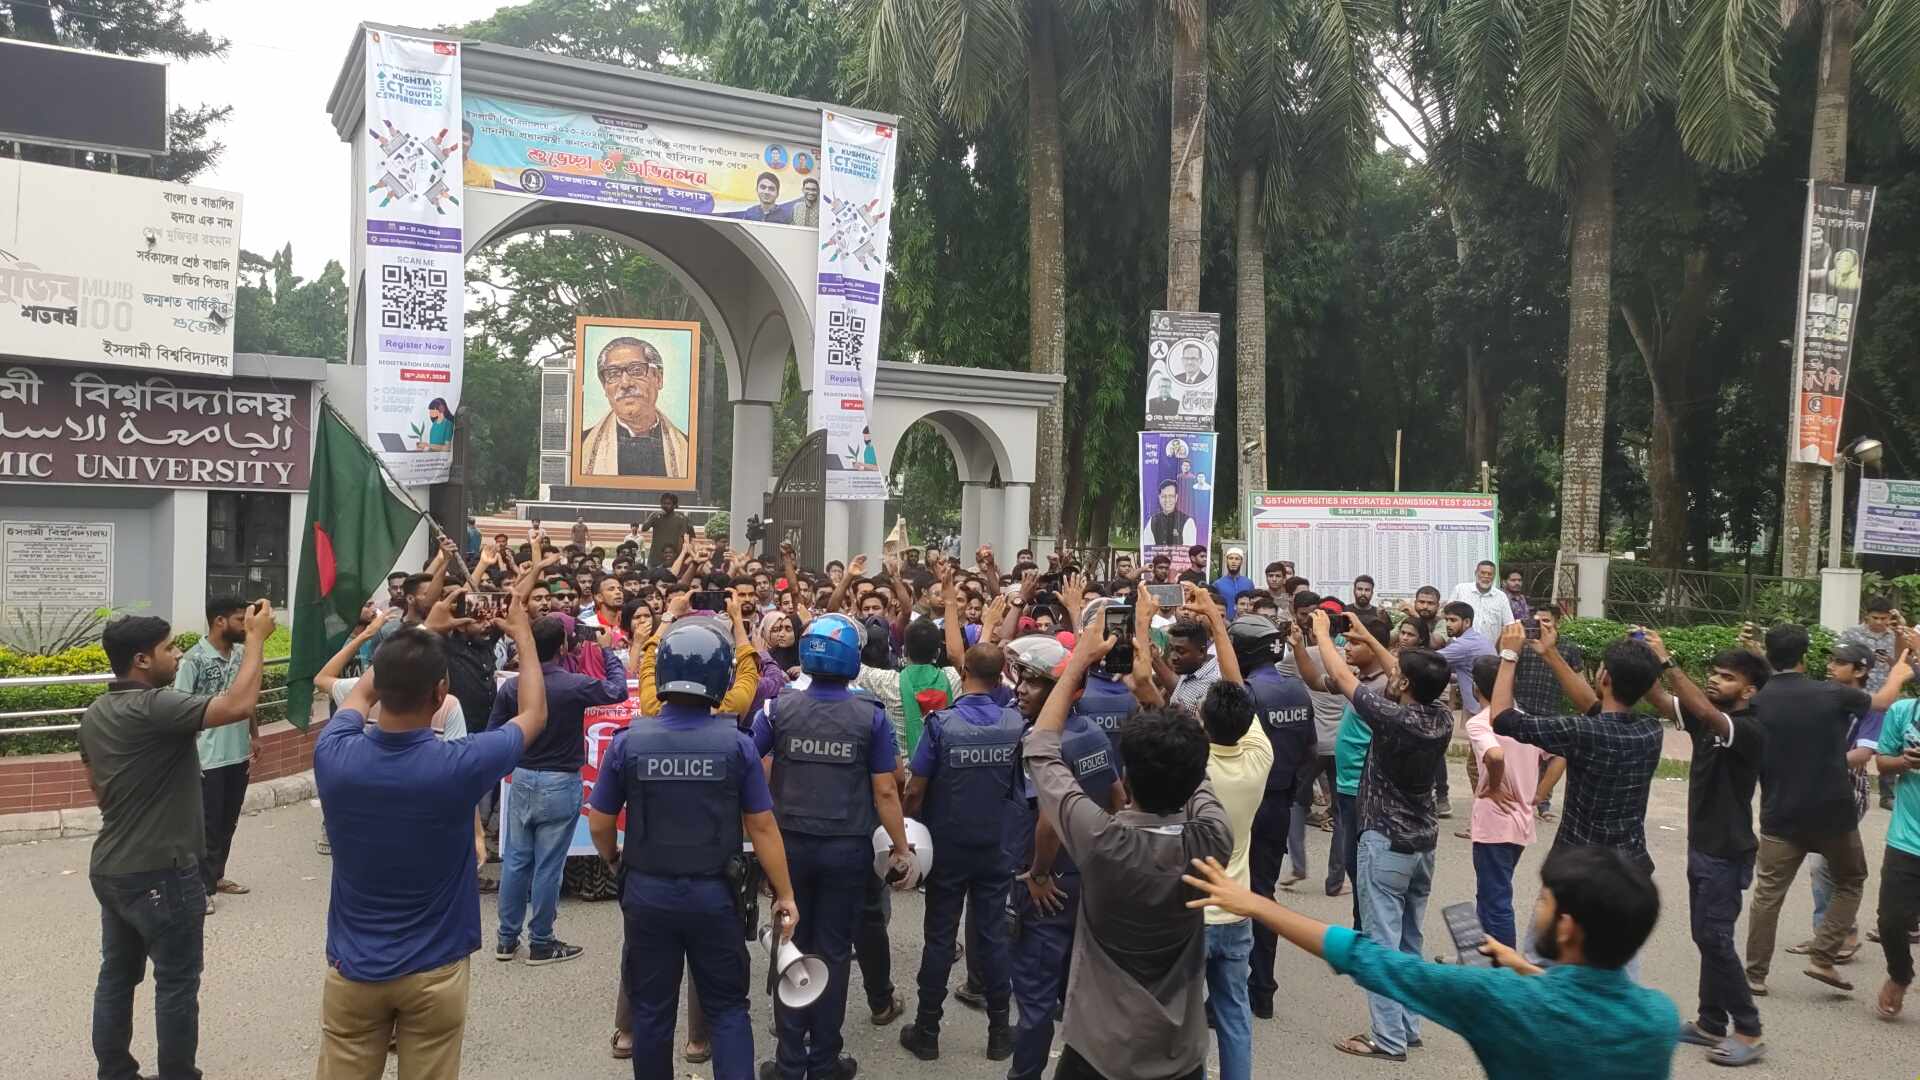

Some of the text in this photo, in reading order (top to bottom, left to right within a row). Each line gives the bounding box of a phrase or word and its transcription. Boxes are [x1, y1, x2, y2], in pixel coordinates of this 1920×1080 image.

[623, 159, 710, 185] অভিনন্দন
[163, 192, 187, 205] বাংলা
[190, 196, 198, 206] ও
[198, 216, 215, 226] এক
[216, 217, 233, 229] নাম
[136, 249, 179, 265] সর্বকালের
[397, 255, 435, 267] SCAN ME
[81, 277, 133, 299] MUJIB
[172, 272, 229, 289] জাতির পিতার
[80, 296, 133, 331] 100
[102, 338, 229, 367] ইসলামী বিশ্ববিদ্যালয়
[385, 339, 445, 351] Register Now
[70, 372, 296, 422] বিশ্ববিদ্যালয়
[117, 411, 293, 457] الجامعة
[75, 453, 295, 486] UNIVERSITY
[1265, 496, 1338, 505] GST-UNIVERSITIES
[1340, 496, 1391, 505] INTEGRATED
[1393, 497, 1439, 506] ADMISSION
[1440, 498, 1460, 506] TEST
[1268, 708, 1308, 725] POLICE
[790, 737, 853, 759] POLICE
[960, 747, 1012, 764] POLICE
[647, 758, 713, 778] POLICE
[1081, 754, 1106, 771] POLICE
